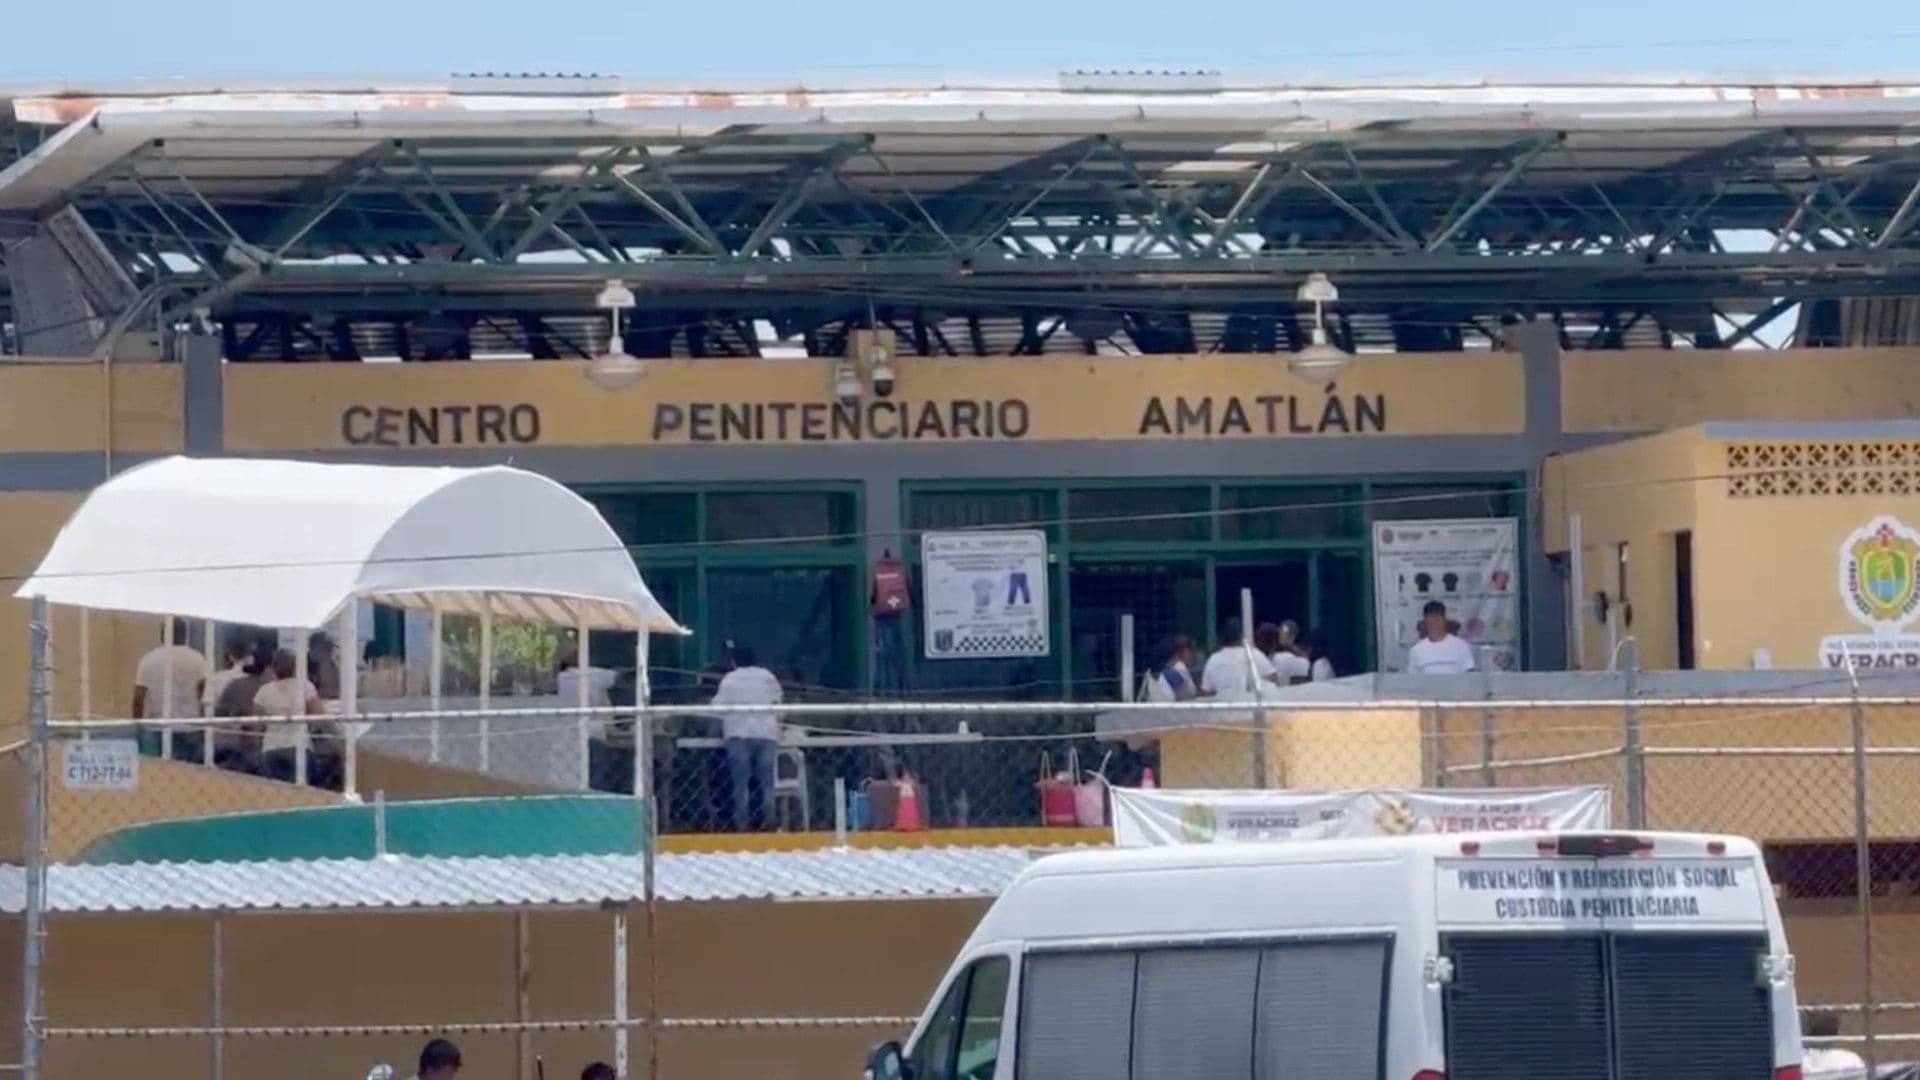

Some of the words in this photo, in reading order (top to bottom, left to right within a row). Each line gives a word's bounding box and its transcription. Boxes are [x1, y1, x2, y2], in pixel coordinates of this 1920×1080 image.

[341, 403, 541, 446] CENTRO
[652, 398, 1030, 441] PENITENCIARIO
[1138, 382, 1386, 435] AMATLÁN
[1430, 815, 1550, 832] VERACRUZ
[1458, 867, 1555, 890] PREVENCIÓN
[1559, 869, 1569, 890] Y
[1572, 867, 1677, 889] REINSERCIÓN
[1682, 867, 1738, 888] SOCIAL
[1495, 897, 1576, 919] CUSTODIA
[1581, 895, 1700, 918] PENITENCIARIA
